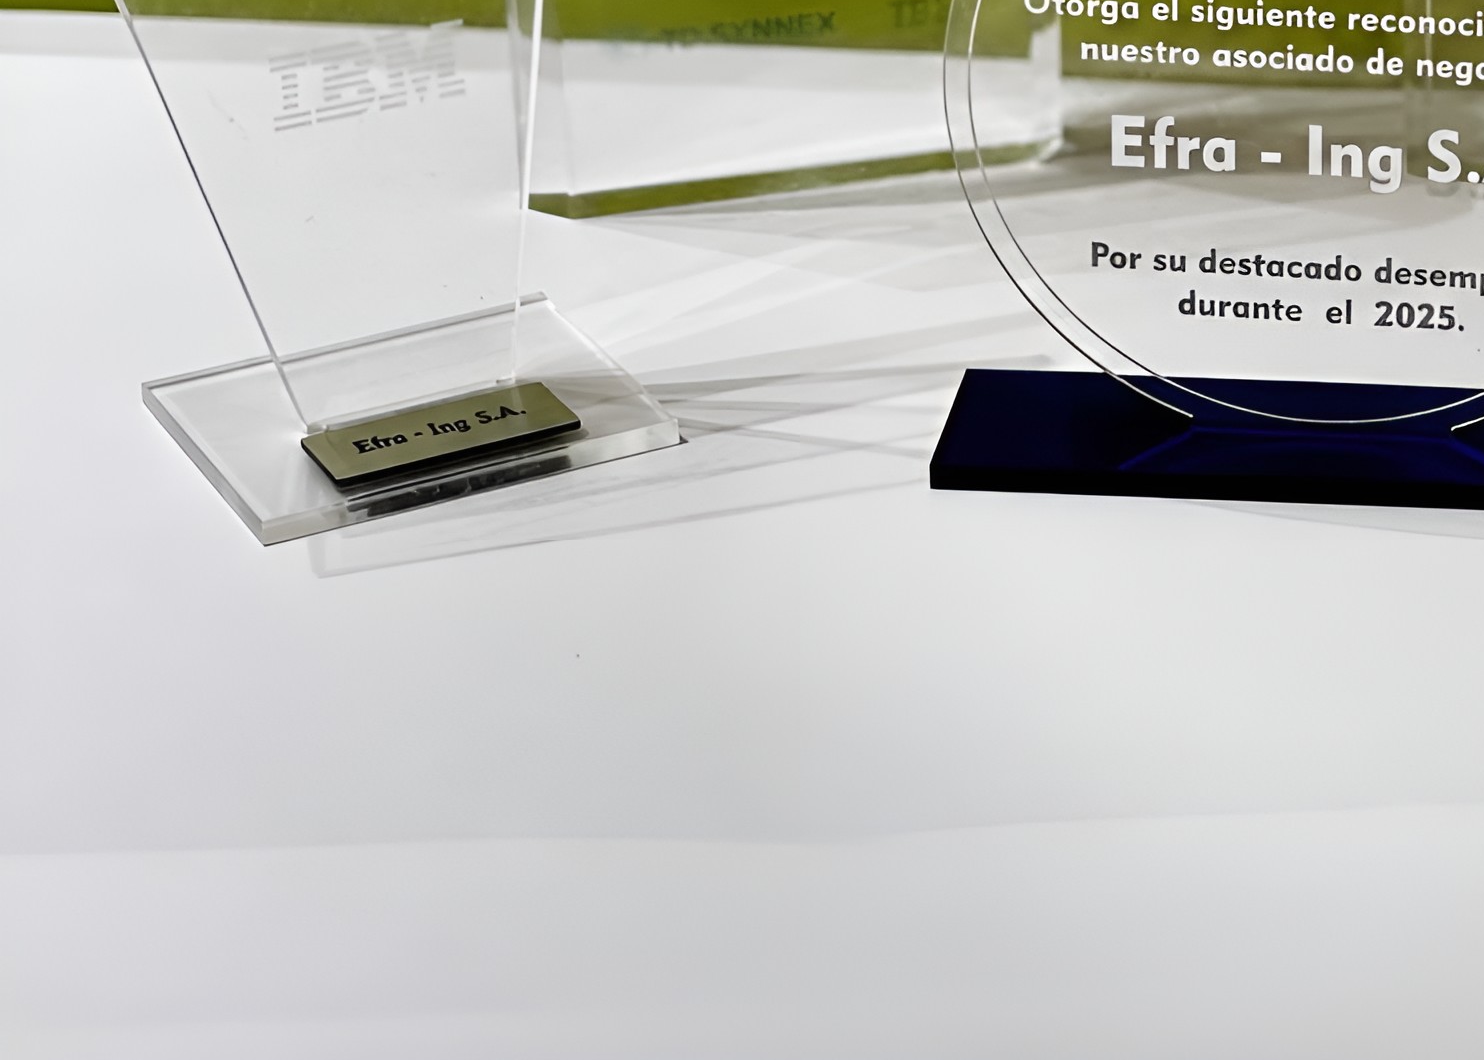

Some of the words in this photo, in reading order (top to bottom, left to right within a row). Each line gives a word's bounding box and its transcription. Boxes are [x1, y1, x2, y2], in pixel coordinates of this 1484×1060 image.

[268, 18, 467, 133] IBM
[1080, 40, 1201, 66] nuestro
[1212, 43, 1355, 74] asociado
[1366, 47, 1404, 77] de
[1110, 114, 1237, 173] Efra
[1307, 123, 1403, 195] Ing
[1090, 241, 1143, 271] Por
[1152, 251, 1188, 274] su
[1199, 248, 1363, 283] destacado
[1177, 289, 1303, 323] durante
[1324, 299, 1353, 326] el
[1373, 300, 1466, 333] 2025.
[351, 434, 409, 455] Efra
[426, 418, 472, 437] Ing
[474, 405, 527, 425] S.A.
